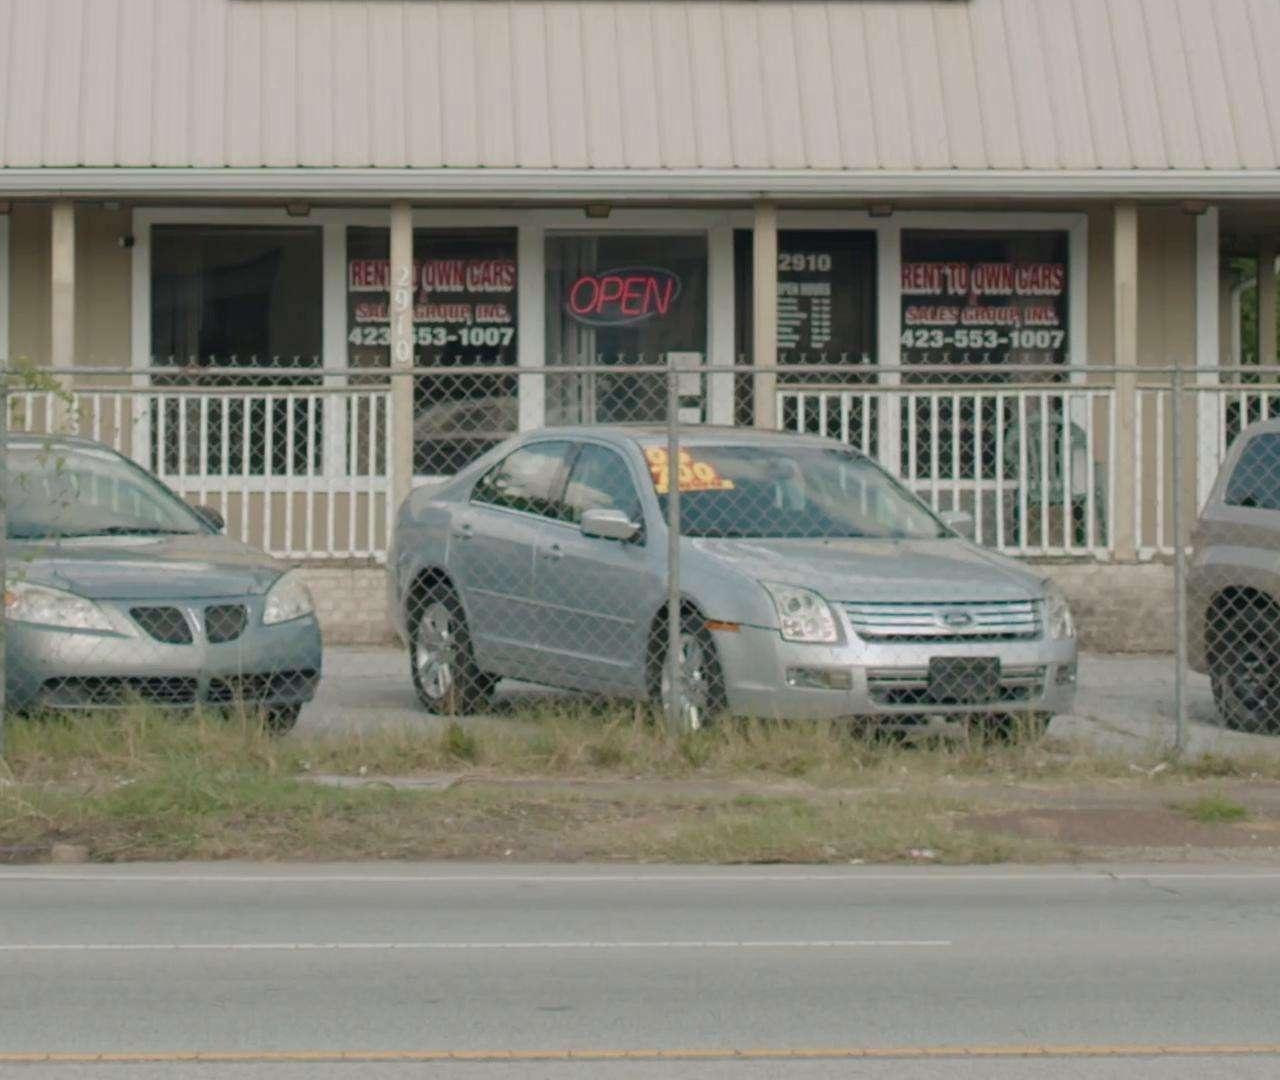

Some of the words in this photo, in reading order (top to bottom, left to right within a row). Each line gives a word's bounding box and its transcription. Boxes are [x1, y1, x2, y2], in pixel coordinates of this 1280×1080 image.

[778, 253, 832, 272] 2910
[423, 260, 465, 292] OWN
[466, 261, 515, 292] CARS
[901, 263, 946, 295] RENT
[945, 263, 969, 295] TO
[972, 263, 1015, 295] OWN
[1015, 263, 1064, 295] CARS
[569, 276, 673, 315] OPEN
[349, 326, 514, 346] 42353-1007
[901, 330, 1064, 348] 423-553-1007
